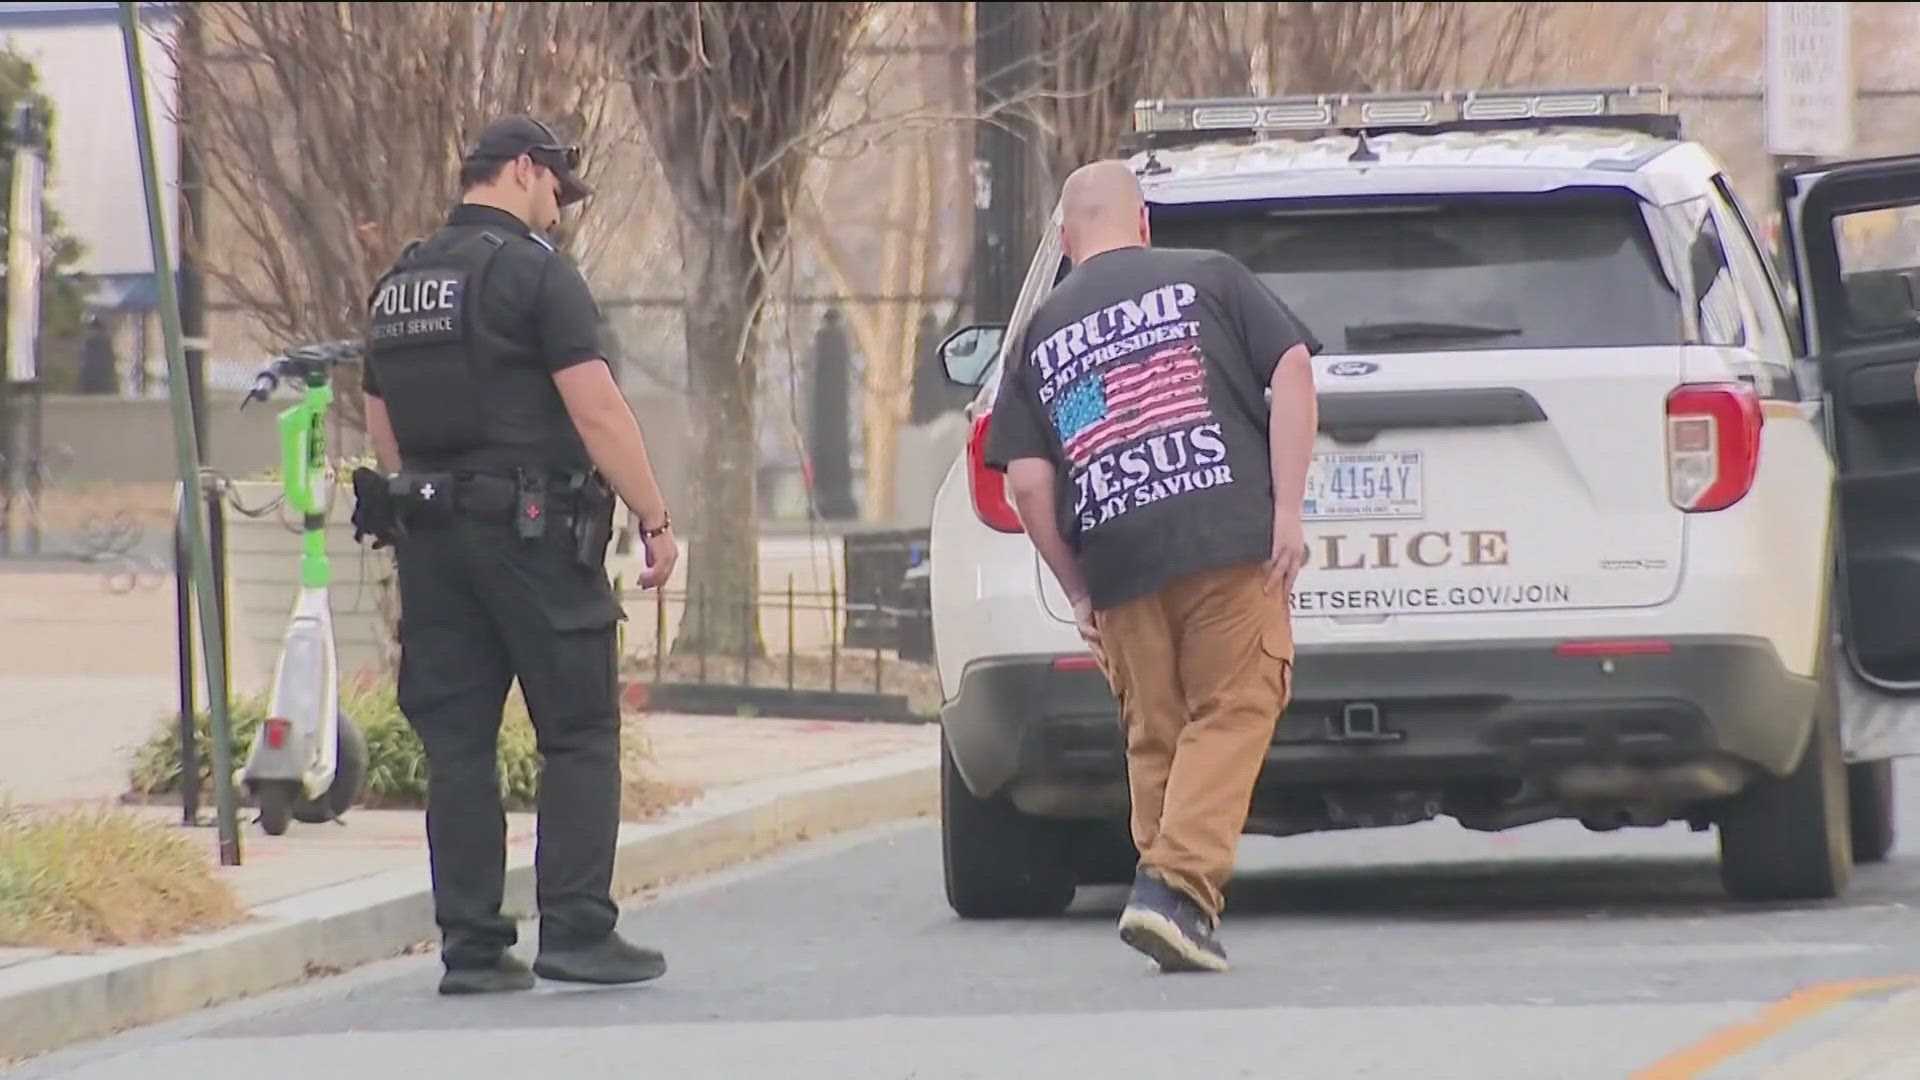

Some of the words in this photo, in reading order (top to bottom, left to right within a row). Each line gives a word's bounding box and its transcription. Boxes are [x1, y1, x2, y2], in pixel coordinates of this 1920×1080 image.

[371, 280, 458, 318] POLICE
[407, 316, 454, 335] SERVICE
[1030, 282, 1198, 380] TRUMP
[1038, 381, 1055, 406] IS
[1055, 362, 1079, 391] MY
[1082, 320, 1200, 372] PRESIDENT
[1074, 423, 1227, 515] JESUS
[1080, 510, 1097, 532] S
[1099, 492, 1129, 525] MY
[1134, 464, 1234, 508] SAVIOR
[1329, 466, 1410, 500] 4154Y
